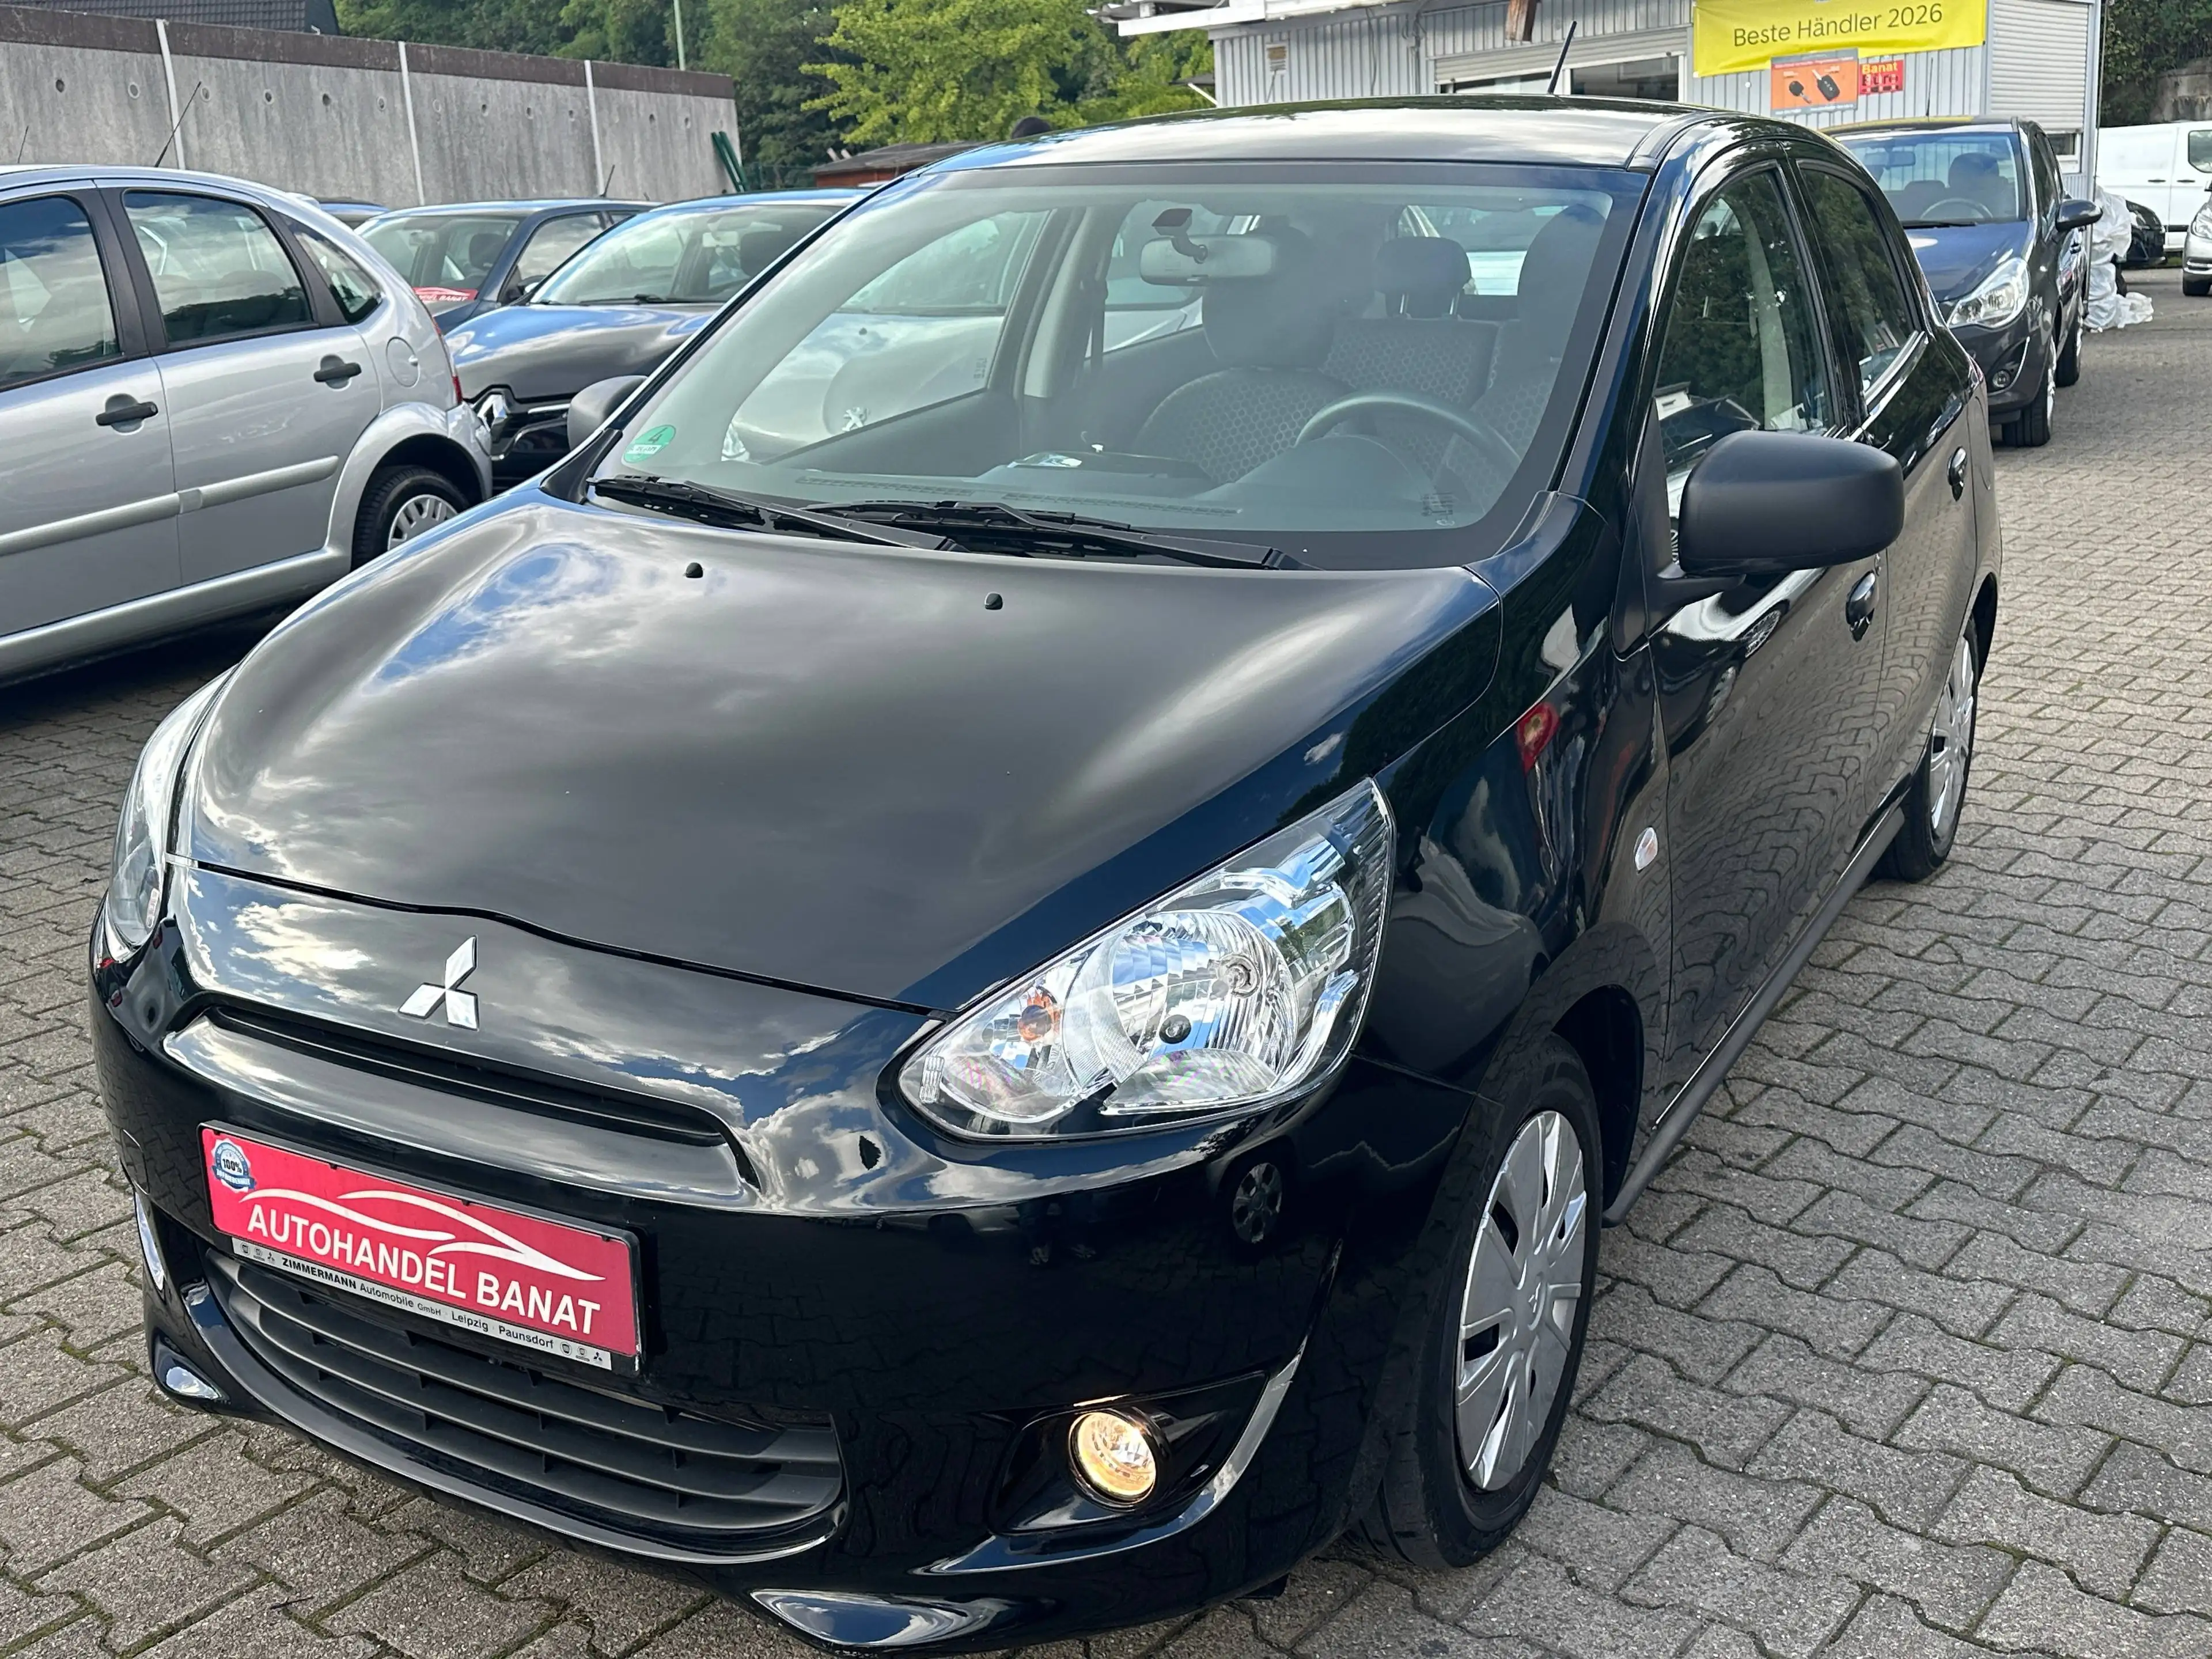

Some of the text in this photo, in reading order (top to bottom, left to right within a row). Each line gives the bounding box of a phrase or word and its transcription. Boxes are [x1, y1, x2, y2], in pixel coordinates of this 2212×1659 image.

[1734, 3, 1942, 47] Beste Händler 2026
[1862, 62, 1898, 74] Banat
[648, 427, 668, 444] 4
[222, 1158, 242, 1173] 100%
[247, 1204, 601, 1335] AUTOHANDEL BANAT
[282, 1257, 554, 1349] ZIMMERMANN Automobile GmbH Leipzig Paunsdorf
